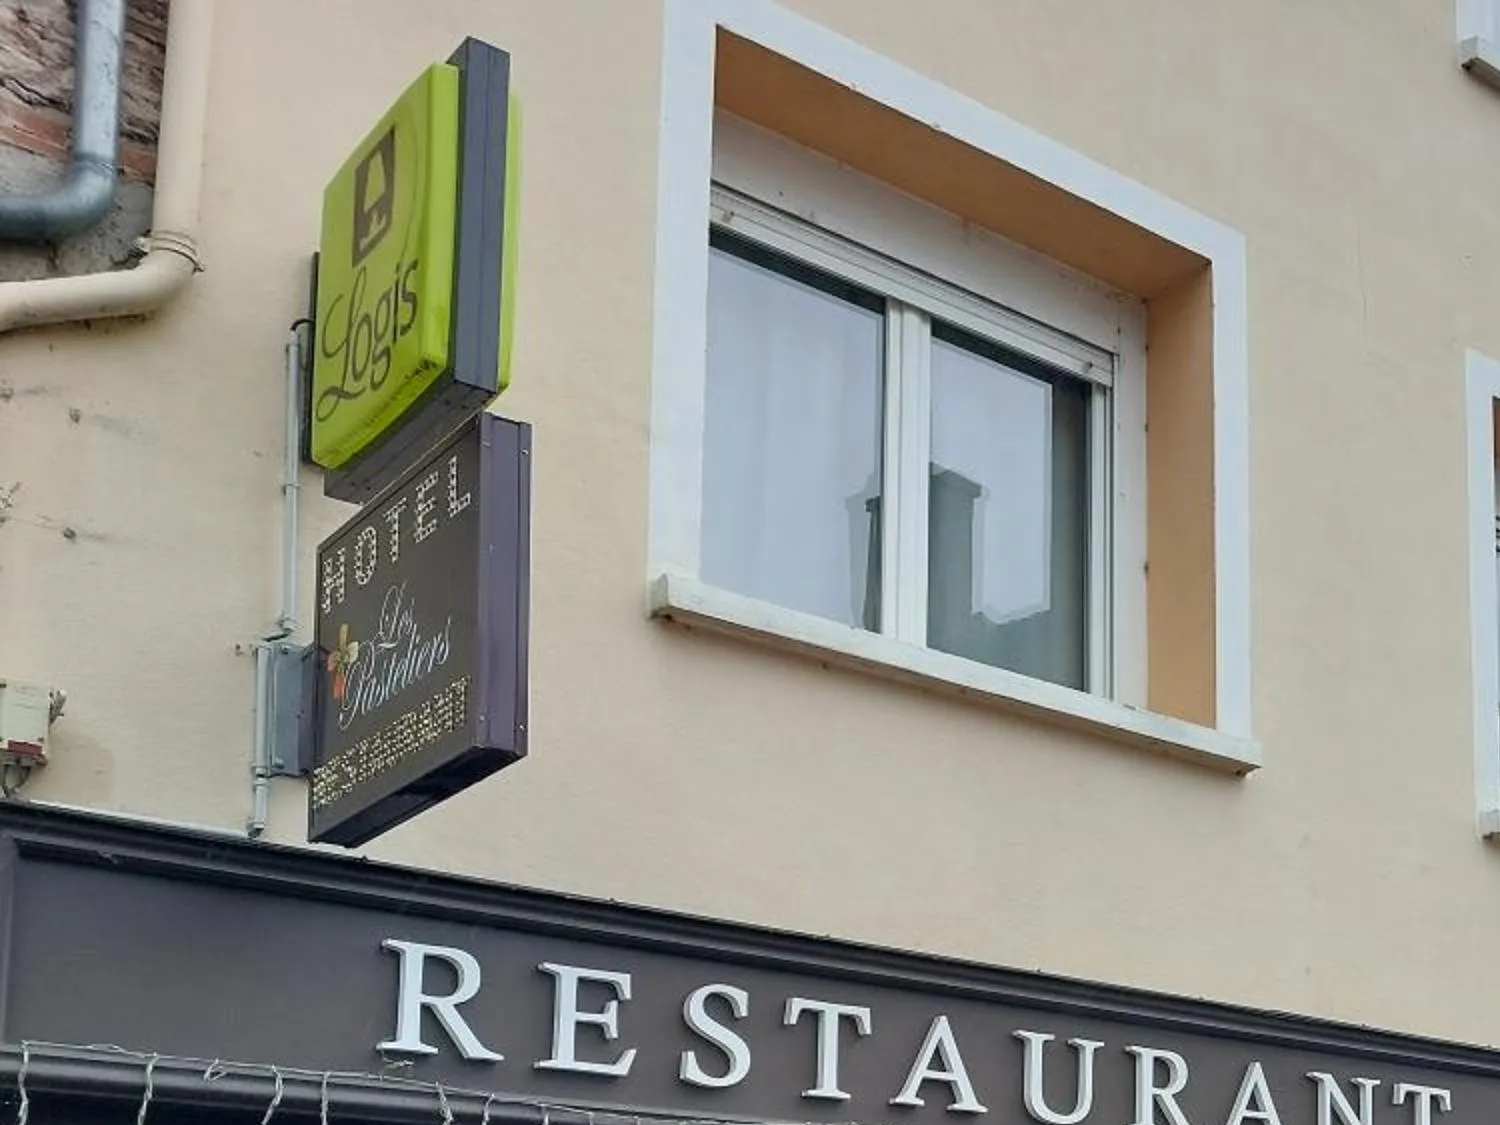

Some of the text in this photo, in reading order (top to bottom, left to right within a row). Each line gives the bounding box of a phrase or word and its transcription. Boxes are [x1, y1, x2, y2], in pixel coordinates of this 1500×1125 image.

[315, 260, 420, 423] Logis
[322, 455, 471, 614] HOTEL
[337, 616, 452, 732] Pasteliers
